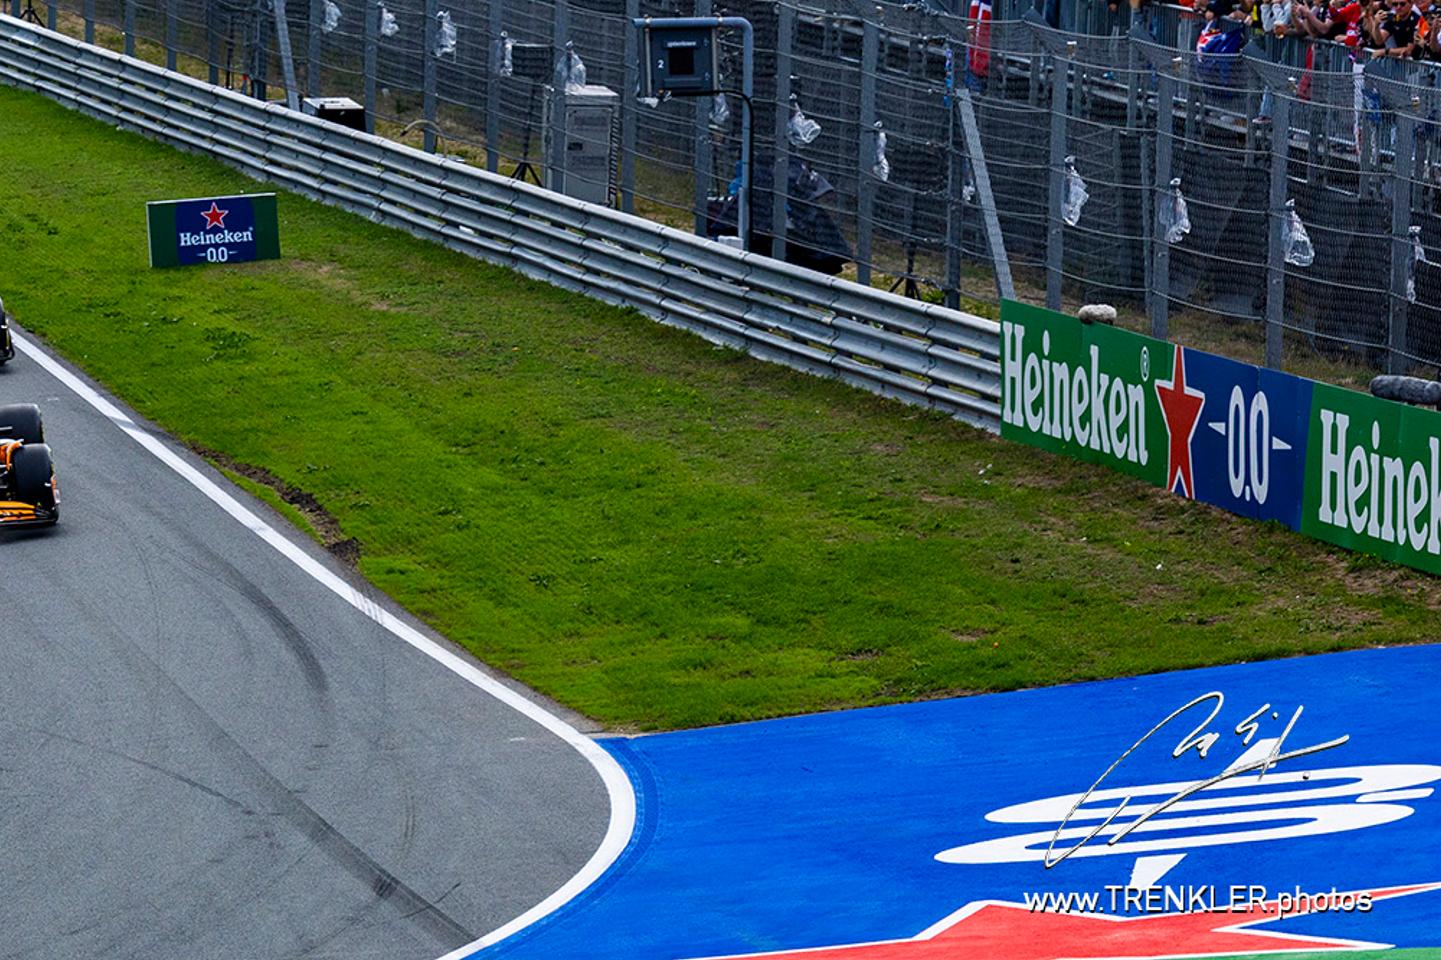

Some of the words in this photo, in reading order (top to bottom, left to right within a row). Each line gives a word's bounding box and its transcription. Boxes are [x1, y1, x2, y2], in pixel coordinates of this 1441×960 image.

[657, 60, 664, 68] 2
[180, 228, 254, 246] Heineken
[1002, 321, 1148, 467] Heineken
[1227, 385, 1270, 505] 0.0
